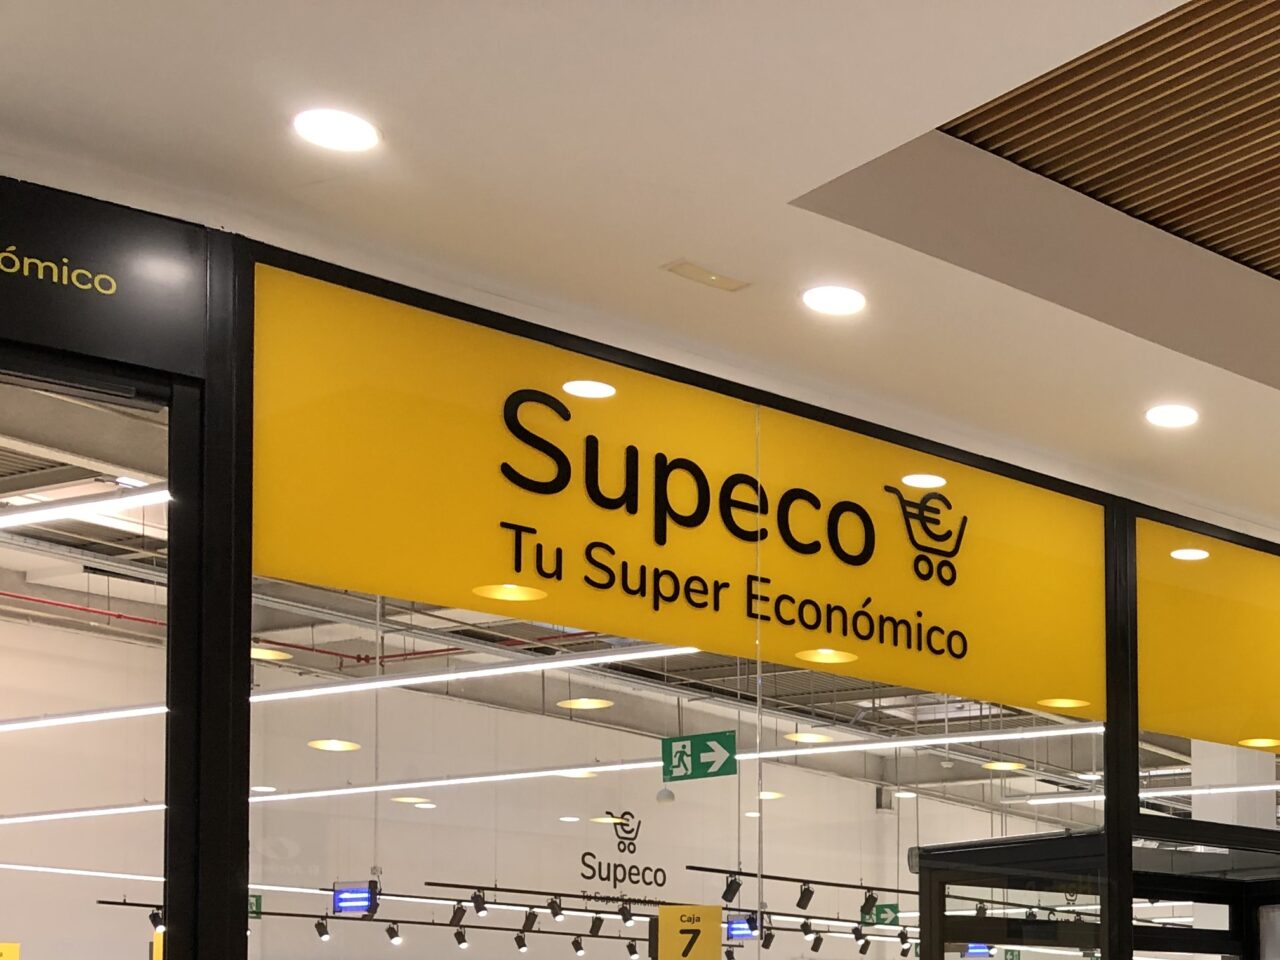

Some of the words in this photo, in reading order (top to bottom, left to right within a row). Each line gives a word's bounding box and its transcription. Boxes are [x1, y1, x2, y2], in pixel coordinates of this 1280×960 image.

[500, 388, 876, 567] Supeco
[499, 521, 564, 581] Tu
[583, 540, 730, 612] Super
[746, 573, 969, 661] Económico
[580, 851, 667, 889] Supeco
[679, 914, 701, 925] Caja
[679, 928, 701, 958] 7
